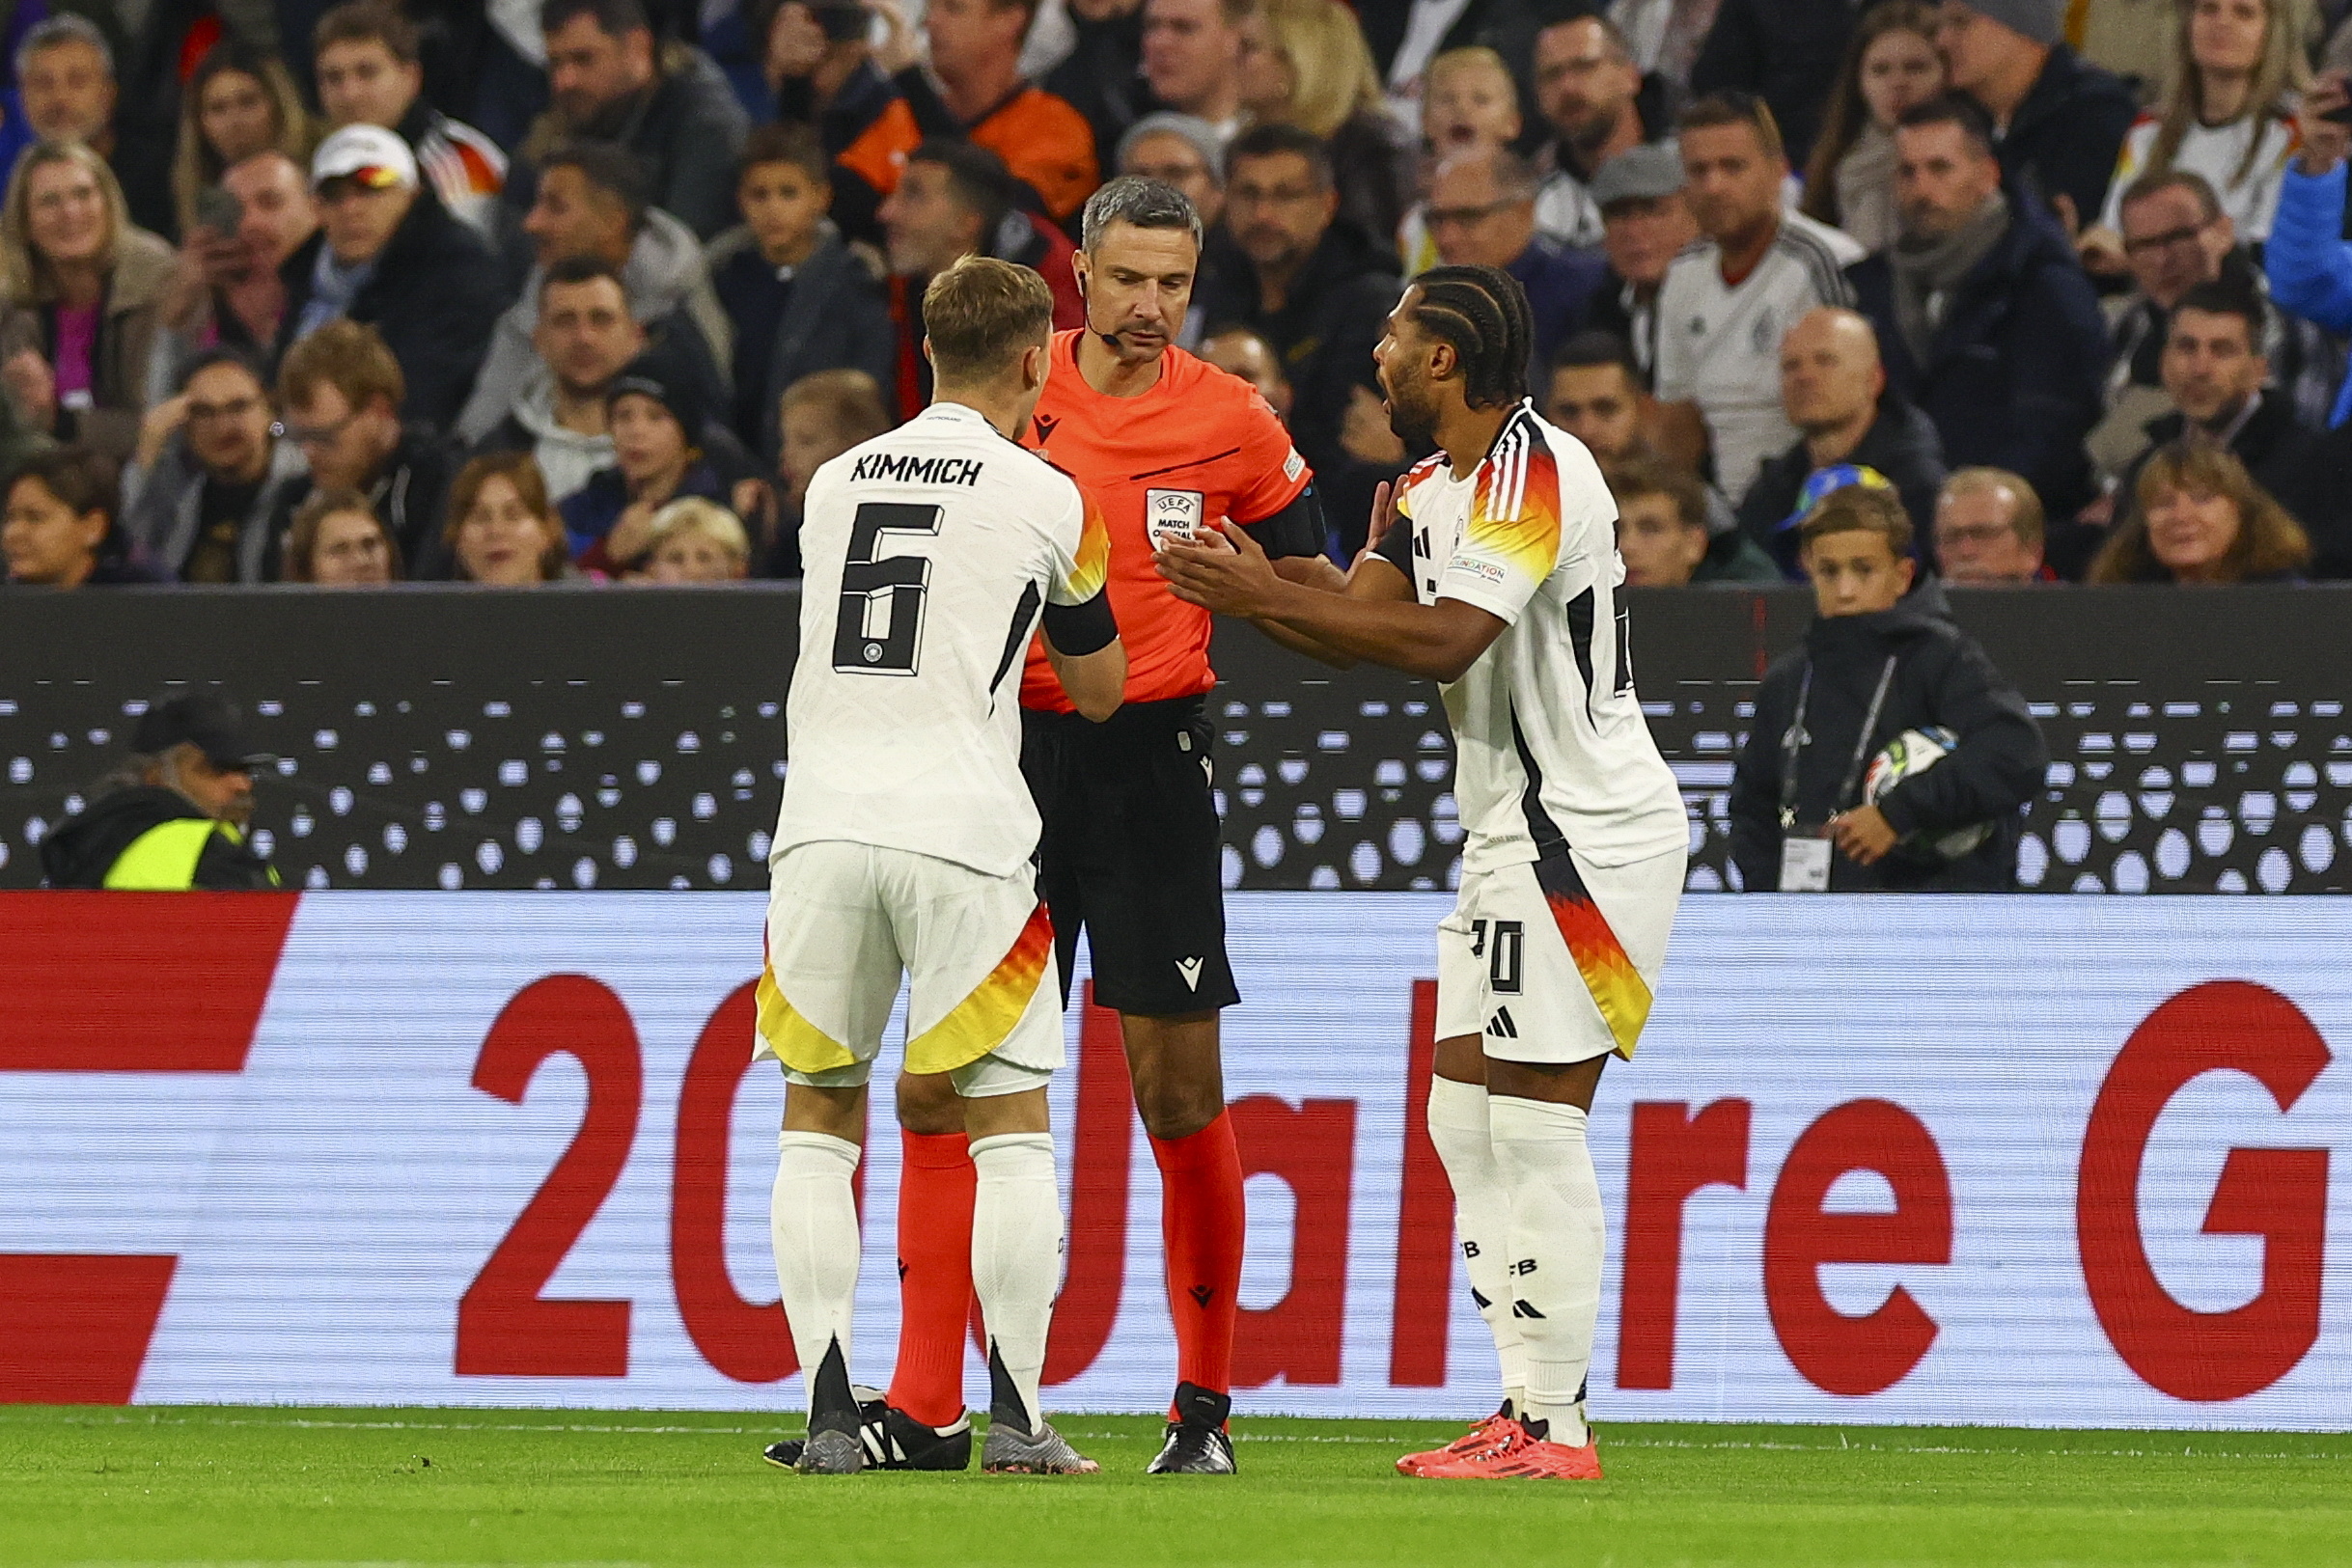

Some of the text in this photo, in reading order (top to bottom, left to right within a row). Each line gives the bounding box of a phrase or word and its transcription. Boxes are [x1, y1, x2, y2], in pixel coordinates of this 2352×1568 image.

[850, 454, 983, 486] KIMMICH
[1158, 498, 1190, 513] UEFA
[1152, 530, 1192, 540] OIAL
[1158, 519, 1190, 530] MATCH
[832, 503, 945, 677] 6
[456, 975, 867, 1384] 20
[2077, 978, 2334, 1402] G
